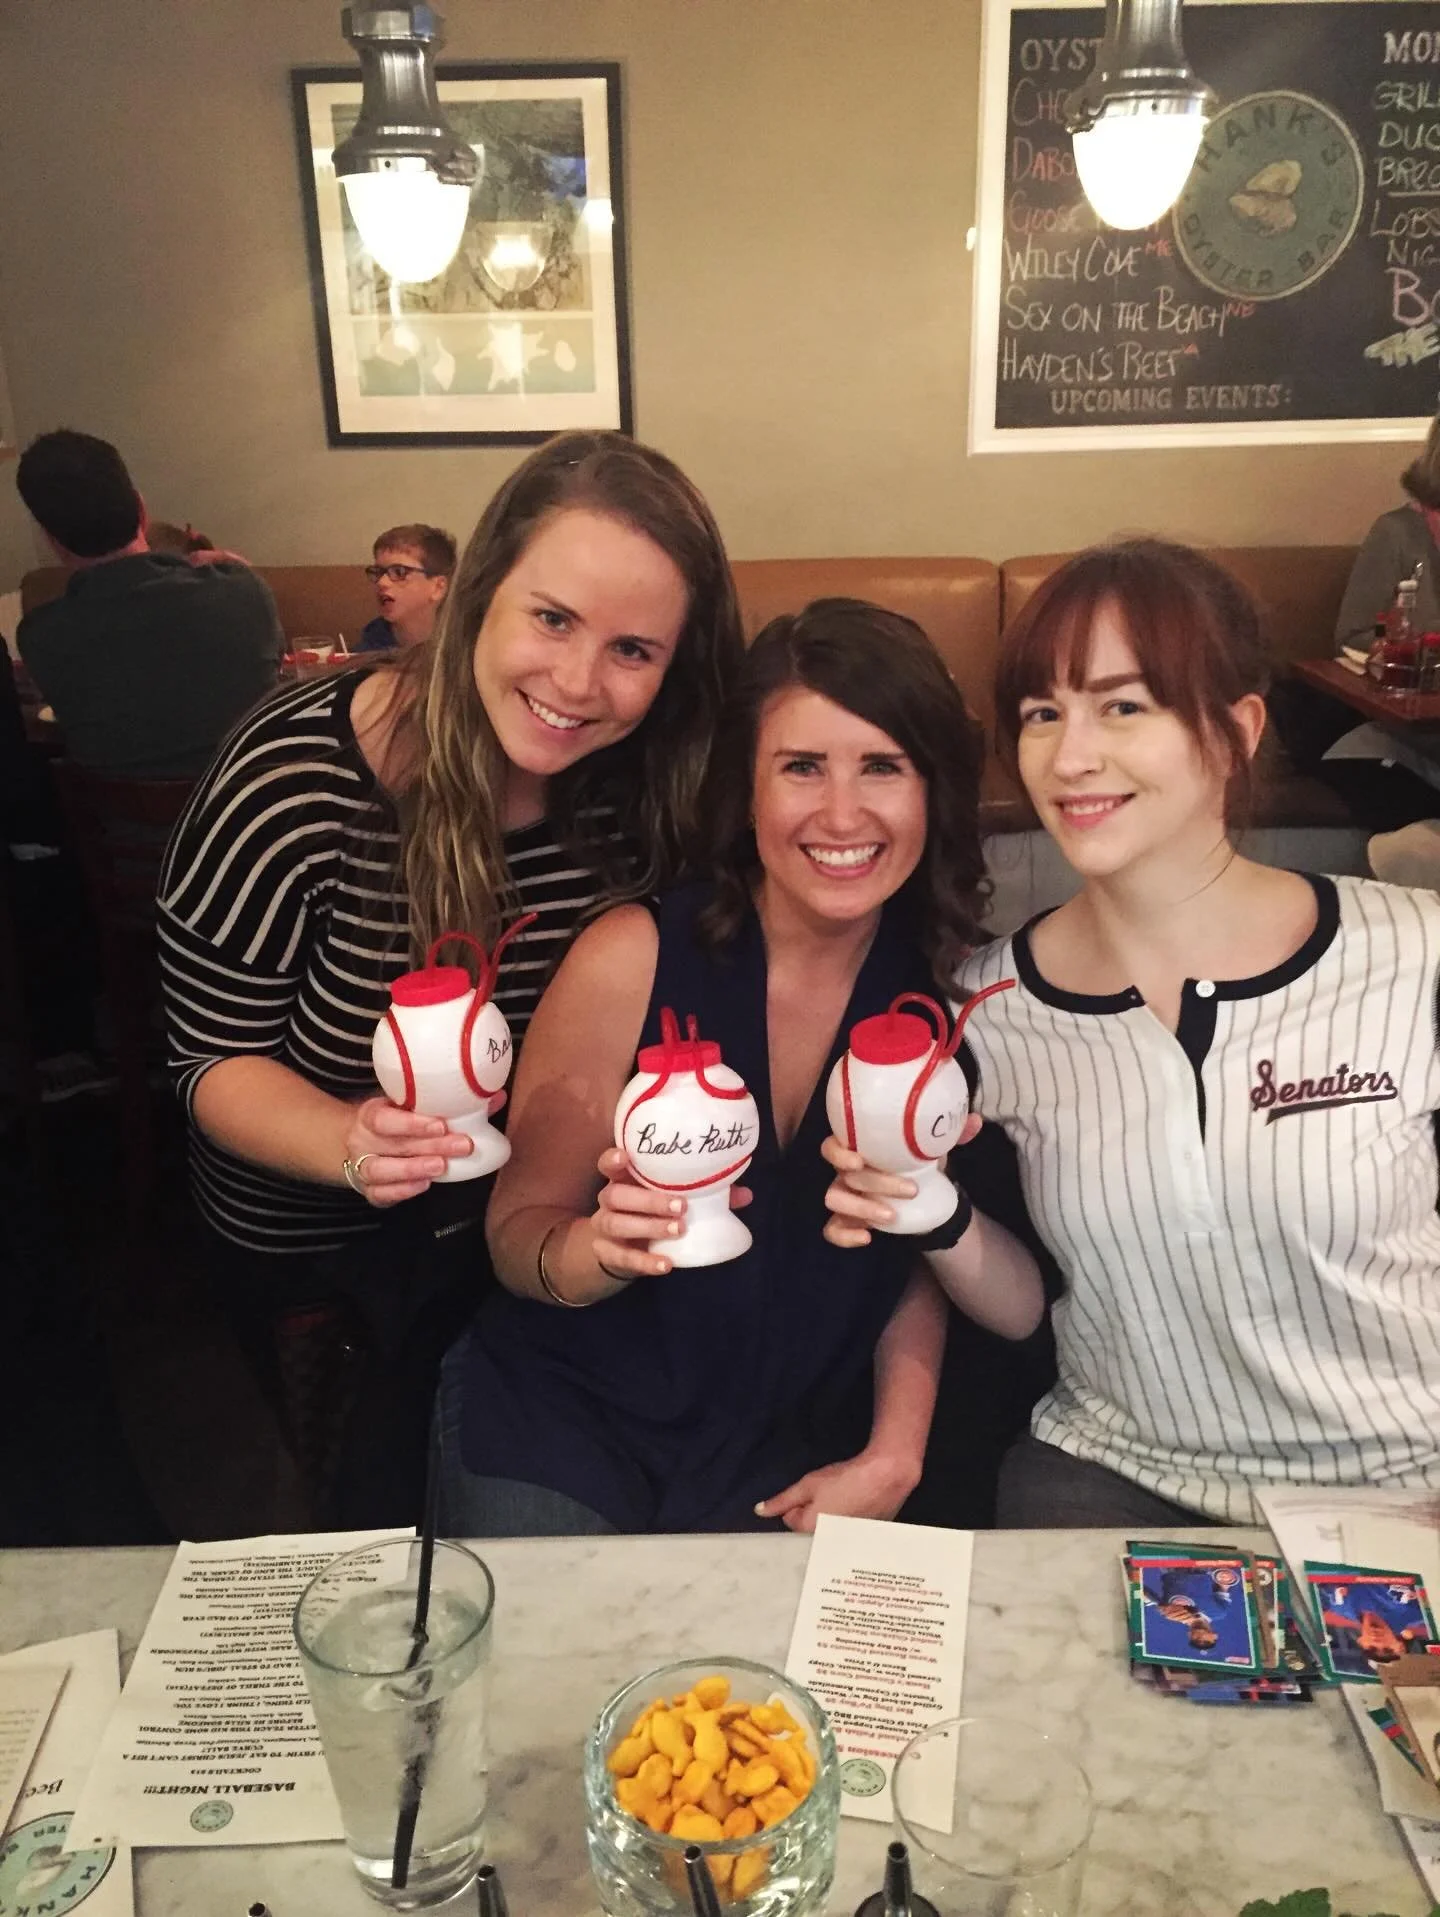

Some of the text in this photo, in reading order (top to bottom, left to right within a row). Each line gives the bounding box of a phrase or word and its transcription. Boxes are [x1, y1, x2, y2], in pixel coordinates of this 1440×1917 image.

[1297, 209, 1350, 272] BAR
[1061, 303, 1101, 332] ON
[1114, 302, 1150, 331] THE
[1050, 384, 1293, 415] UPCOMING EVENTS:
[1250, 1058, 1399, 1114] Senators
[637, 1120, 752, 1156] Babe Ruth
[143, 1781, 296, 1795] BASEBALL NIGHT!!!
